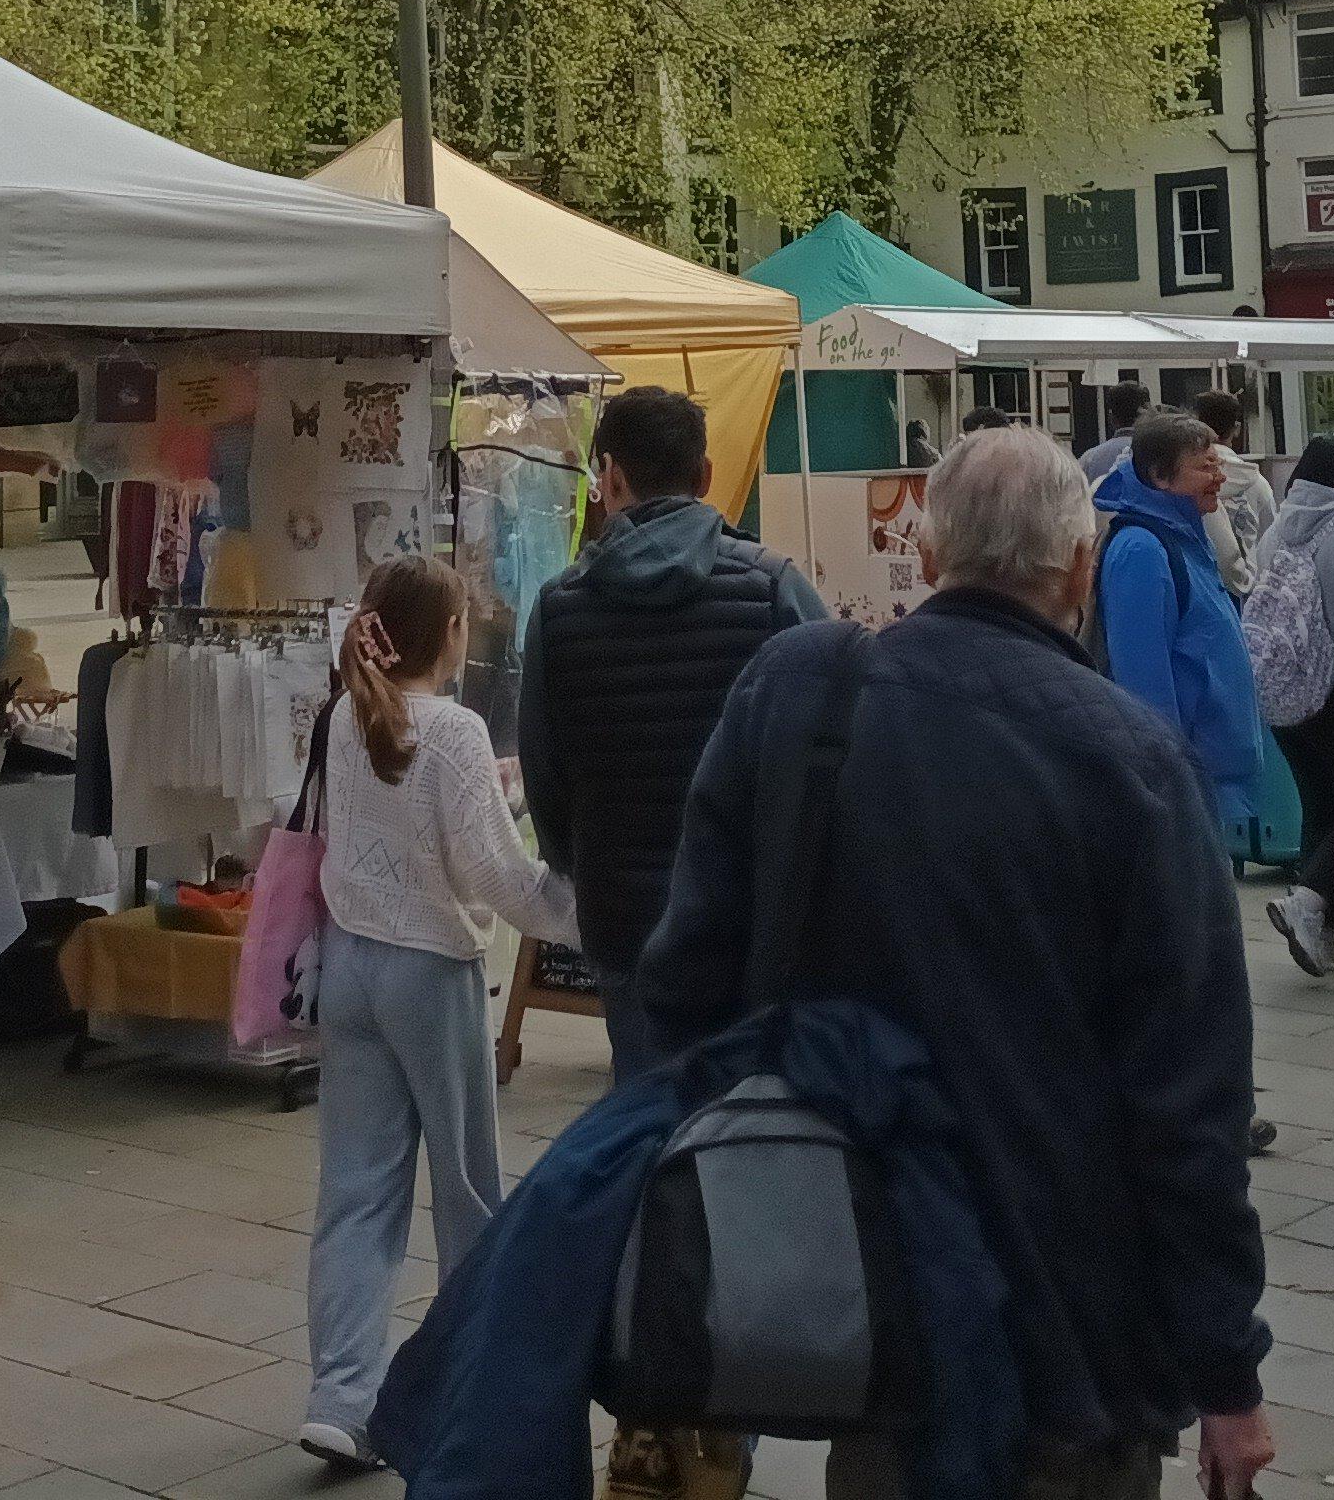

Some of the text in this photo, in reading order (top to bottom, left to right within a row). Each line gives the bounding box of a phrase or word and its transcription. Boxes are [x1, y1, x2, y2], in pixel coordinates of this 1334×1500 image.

[816, 313, 859, 358] Food
[829, 332, 904, 368] on the go!
